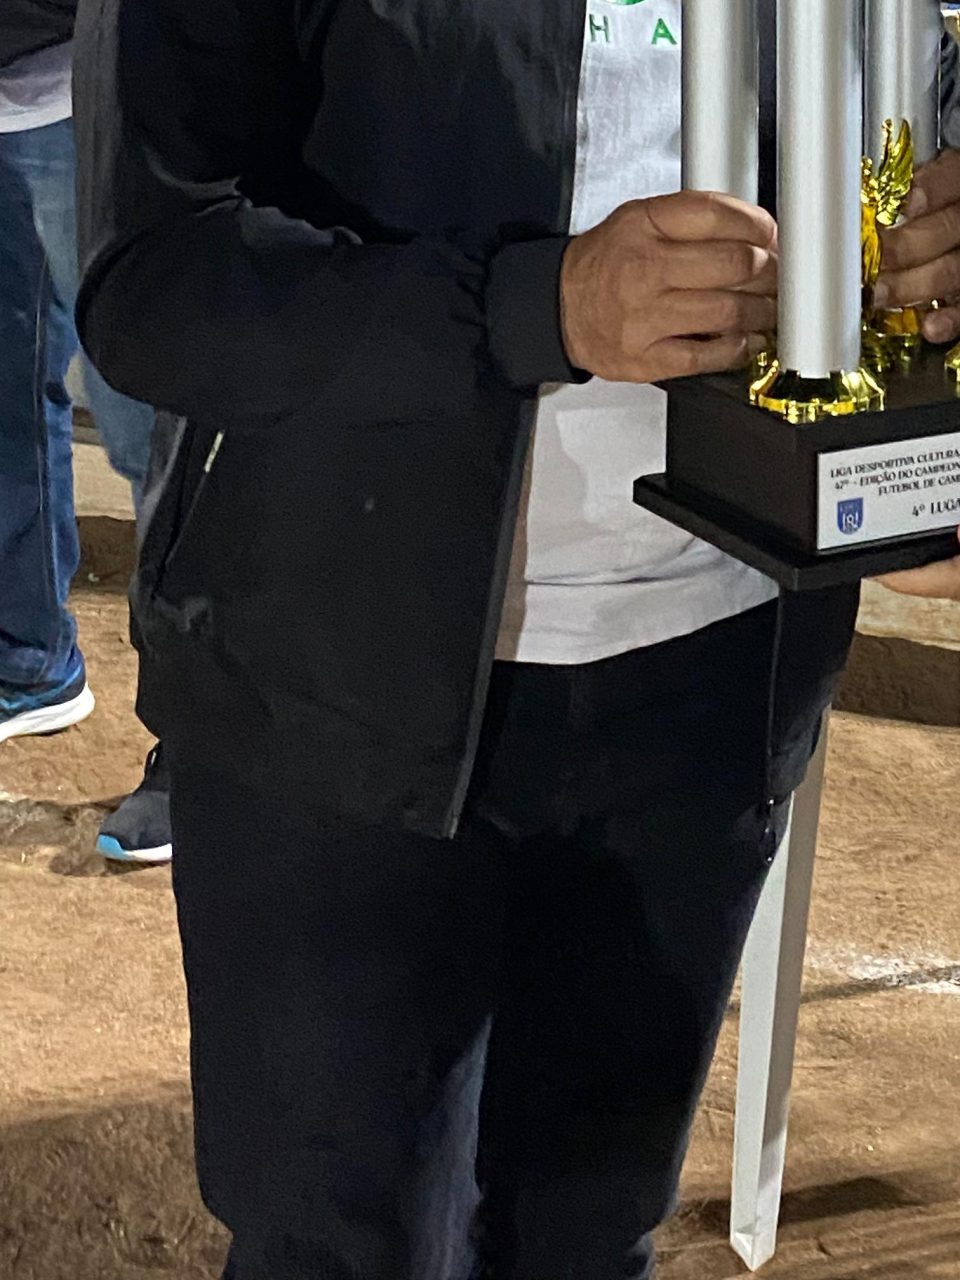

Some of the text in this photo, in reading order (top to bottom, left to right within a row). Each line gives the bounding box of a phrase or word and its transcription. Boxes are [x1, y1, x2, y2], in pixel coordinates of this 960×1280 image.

[830, 466, 852, 479] LIGA
[860, 470, 896, 486] EDIÇÃO
[899, 469, 913, 480] DO
[878, 481, 919, 496] FUTEBOL
[923, 478, 936, 489] DE
